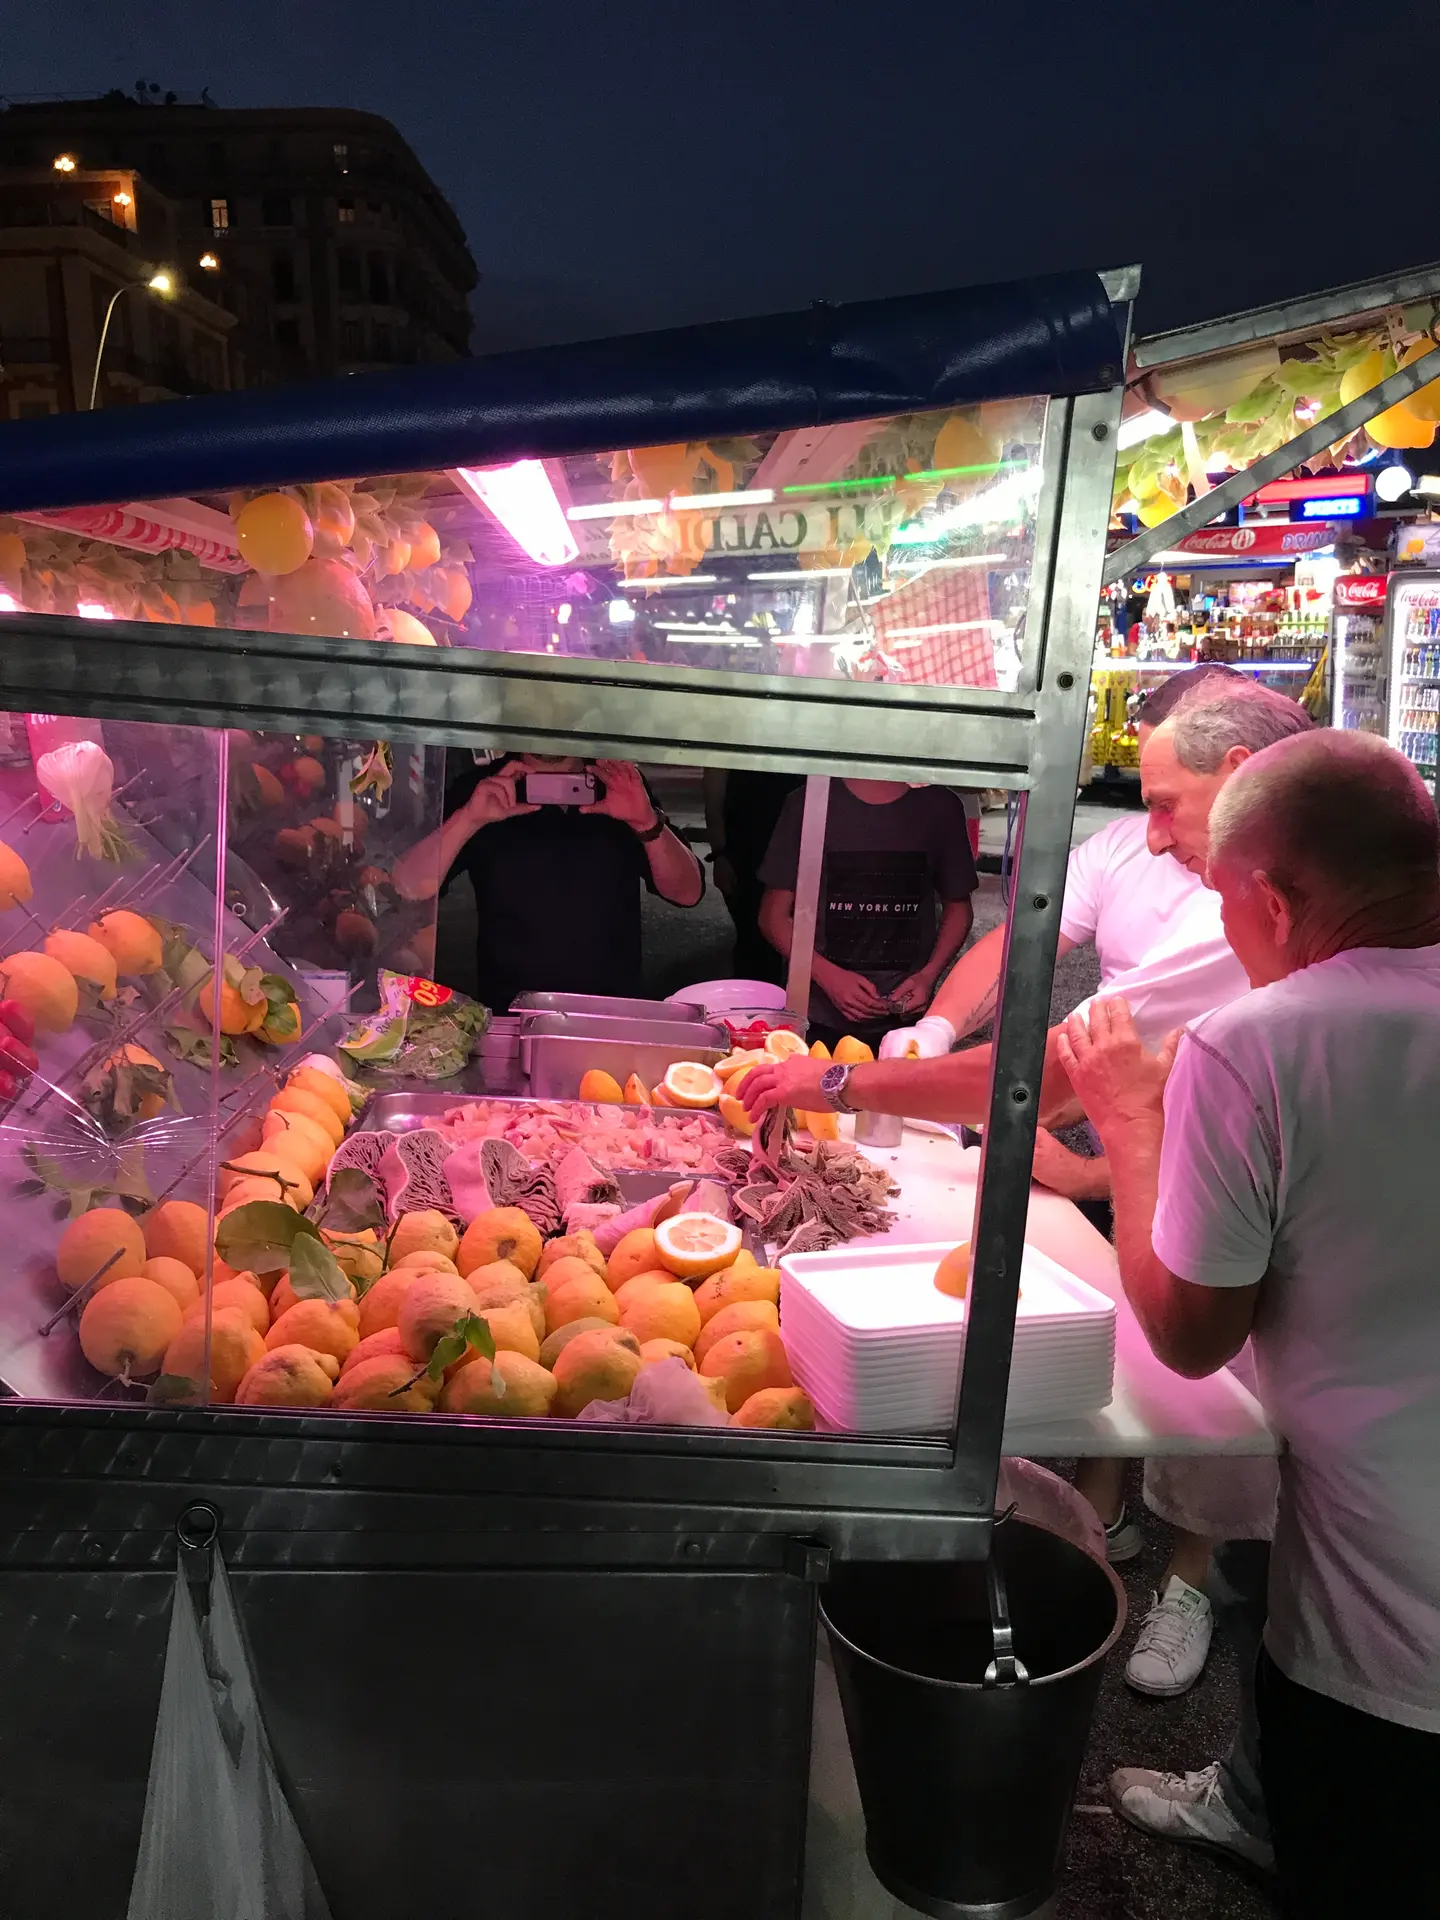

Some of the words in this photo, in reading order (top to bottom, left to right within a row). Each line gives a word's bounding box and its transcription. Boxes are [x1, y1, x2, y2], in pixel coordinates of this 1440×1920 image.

[829, 902, 853, 911] NEW
[859, 903, 889, 912] YORK
[894, 903, 919, 912] CITY
